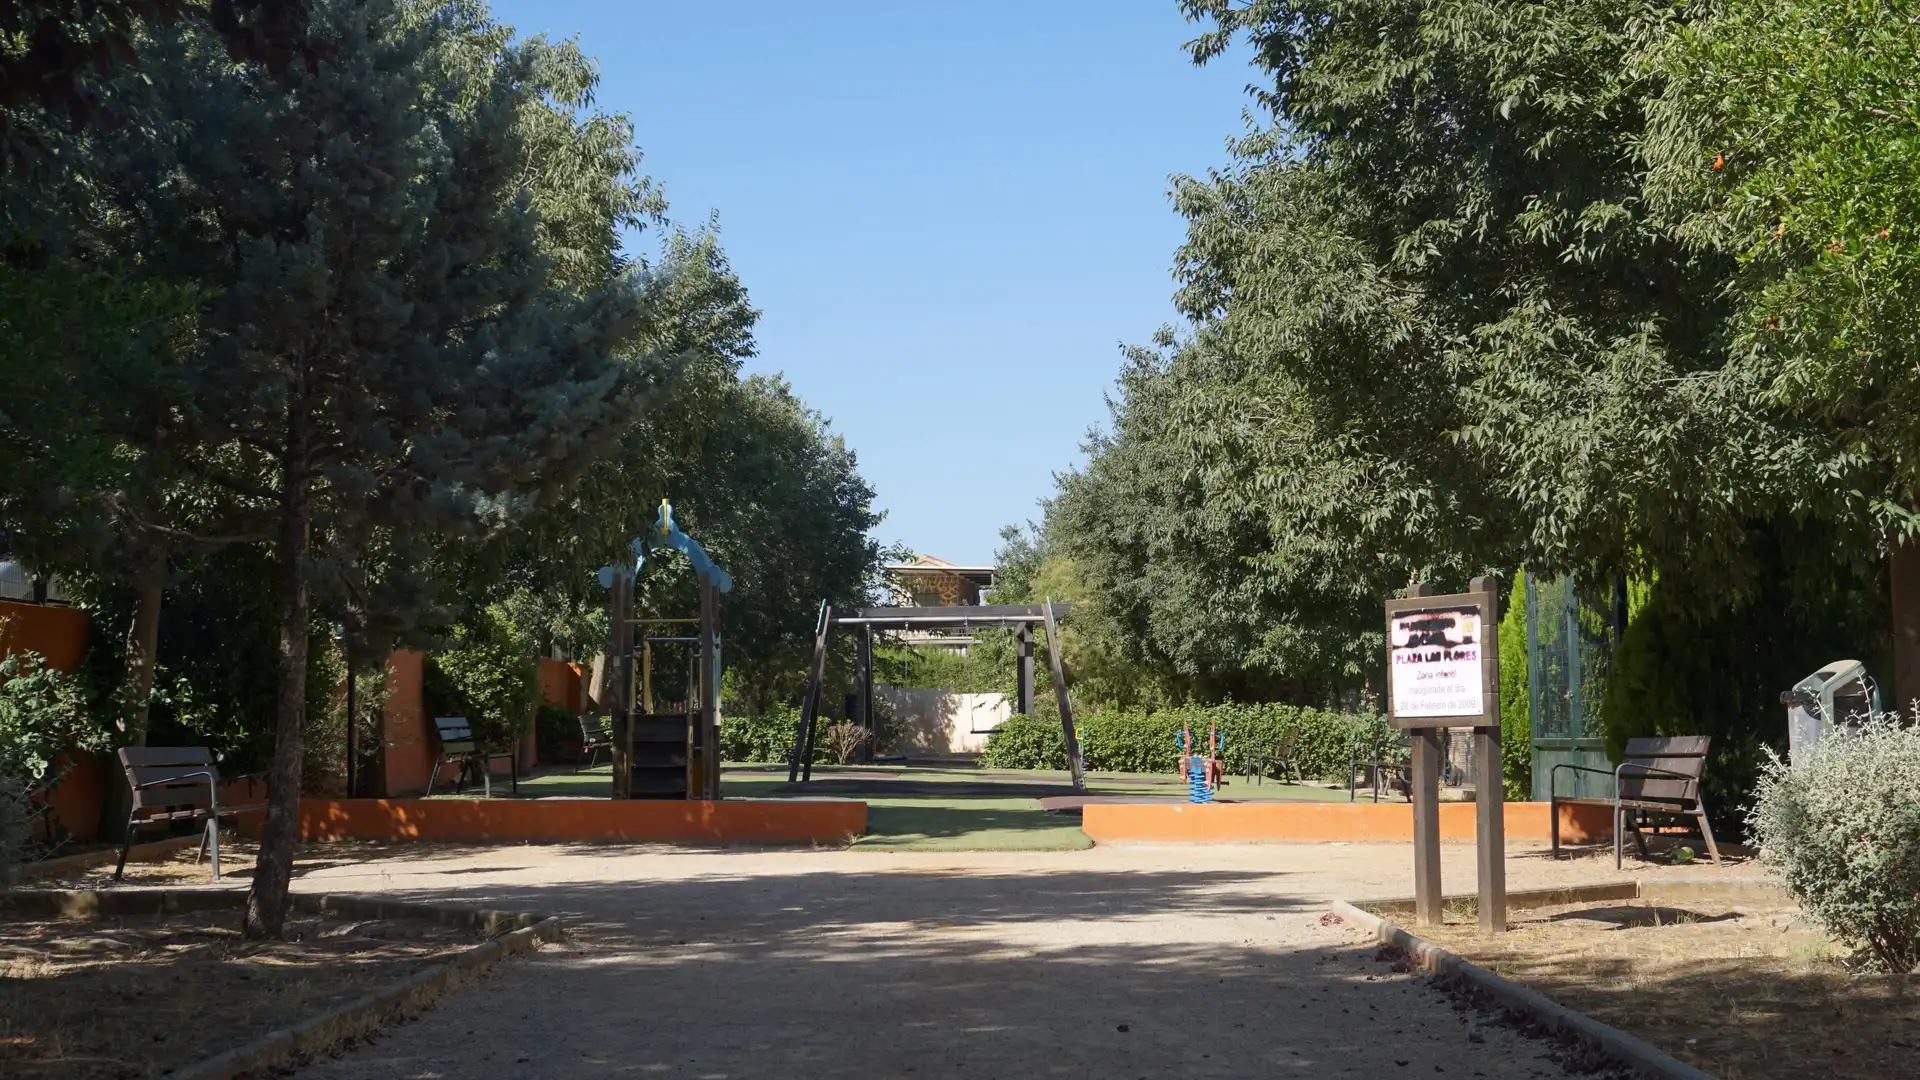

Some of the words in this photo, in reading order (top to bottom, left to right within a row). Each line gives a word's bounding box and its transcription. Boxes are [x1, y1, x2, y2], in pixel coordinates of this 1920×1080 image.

[1396, 653, 1422, 664] PLAZA
[1444, 651, 1477, 661] FLORES
[1410, 701, 1418, 710] de
[1449, 700, 1457, 709] de
